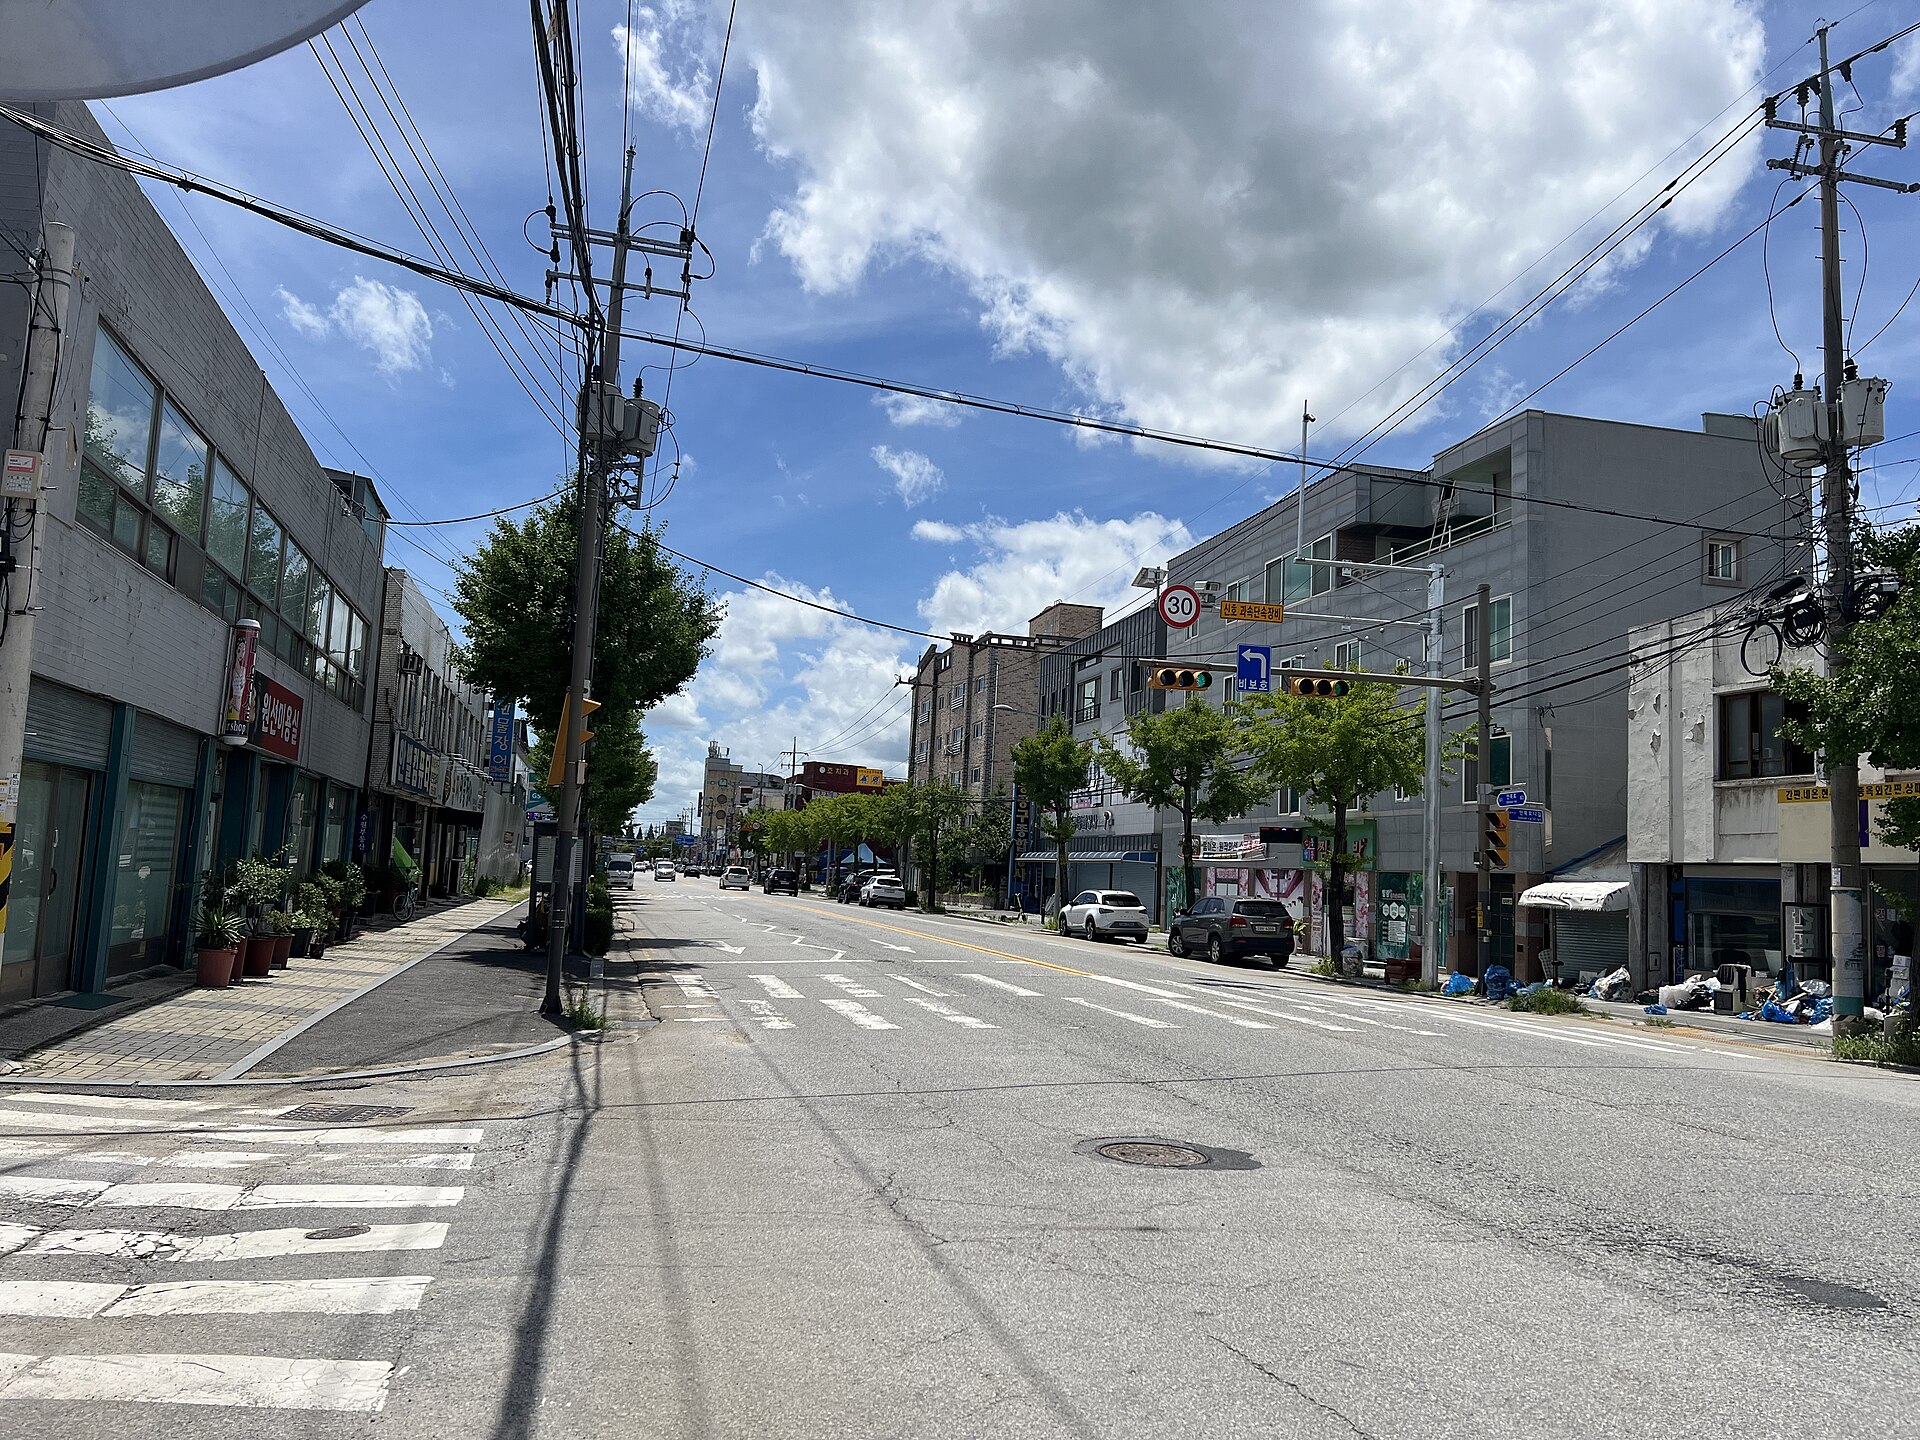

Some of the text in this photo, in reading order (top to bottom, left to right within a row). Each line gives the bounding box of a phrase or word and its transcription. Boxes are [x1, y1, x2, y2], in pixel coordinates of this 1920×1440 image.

[1167, 596, 1193, 616] 30
[1223, 604, 1281, 620] 신호 과속단속장비
[1238, 678, 1269, 691] 비보호
[261, 692, 301, 746] 원선미용실
[230, 721, 247, 735] shop
